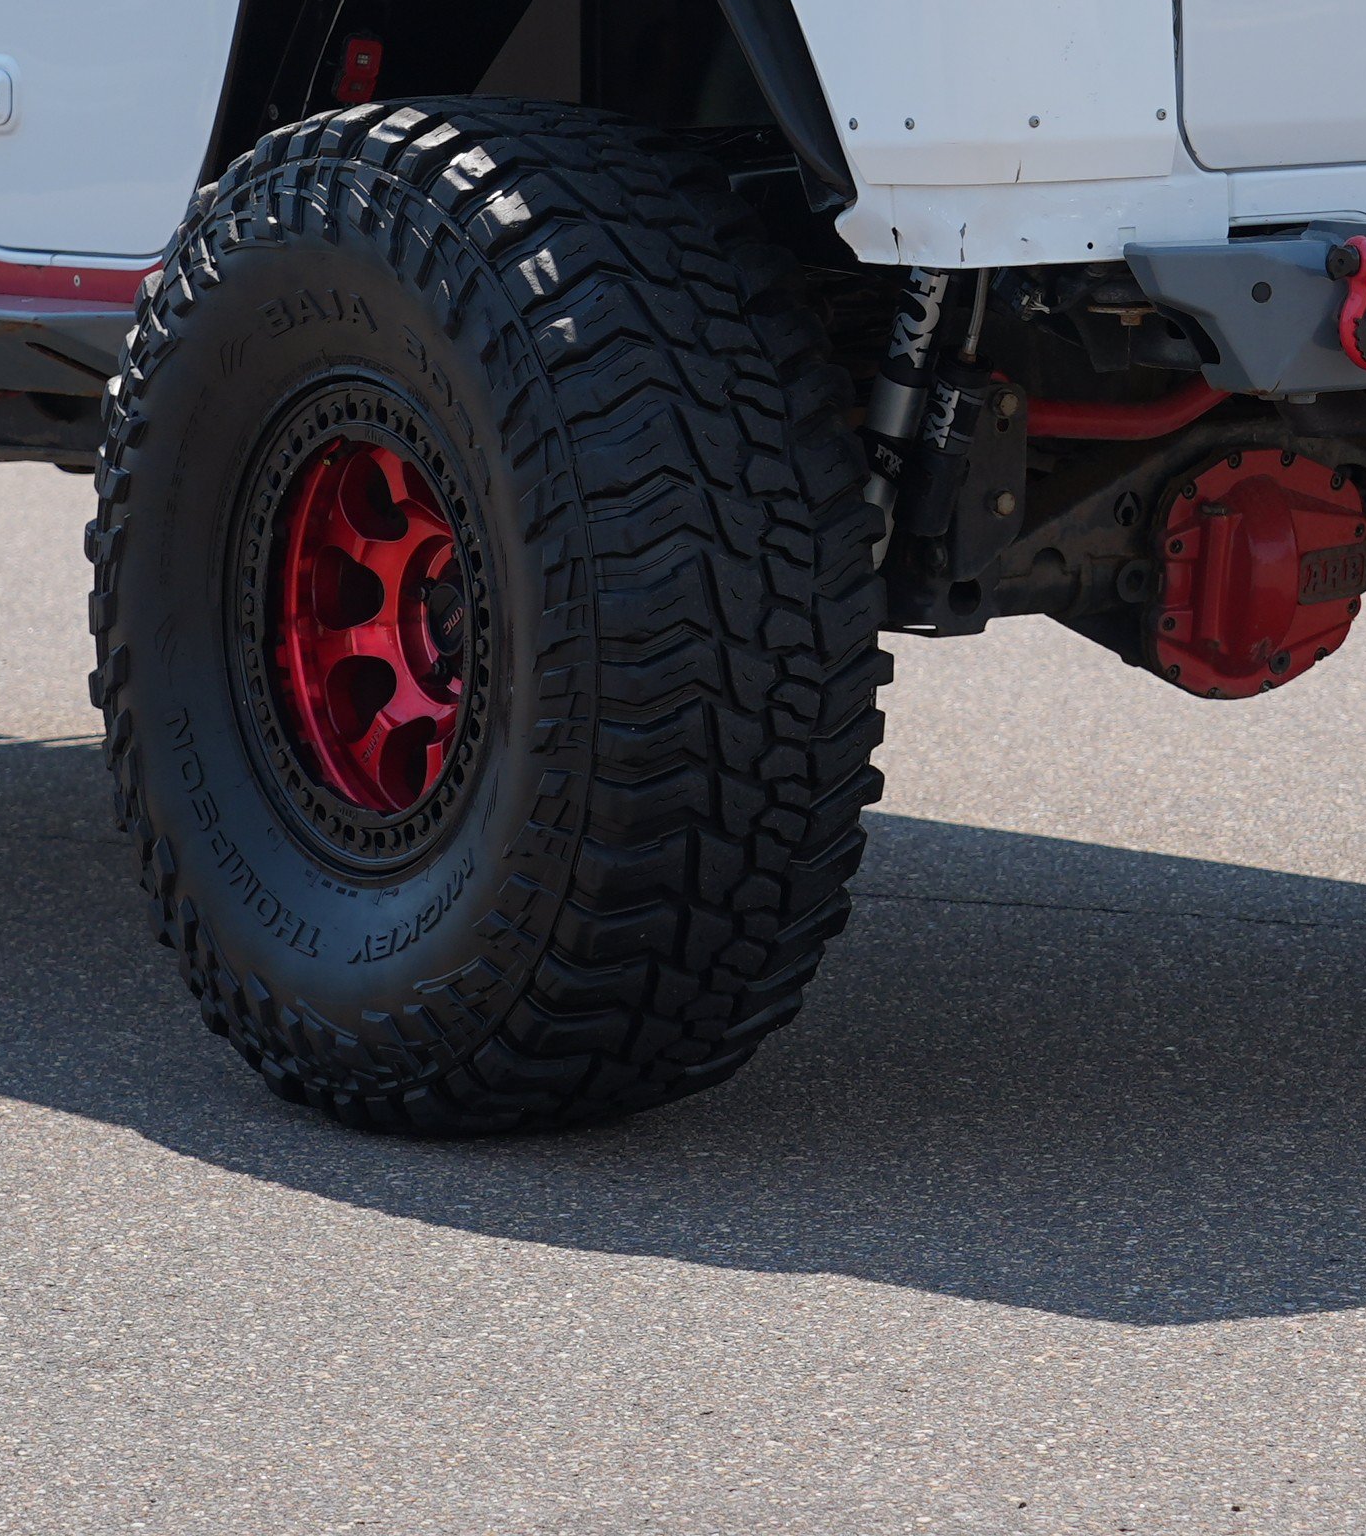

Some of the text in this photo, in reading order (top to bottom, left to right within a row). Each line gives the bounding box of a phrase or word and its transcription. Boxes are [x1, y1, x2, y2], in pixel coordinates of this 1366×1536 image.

[256, 287, 378, 340] BAJA
[888, 265, 950, 369] FOX
[923, 381, 961, 449] FOX
[874, 443, 904, 479] FOX
[163, 705, 476, 965] MICKEY THOMPSON
